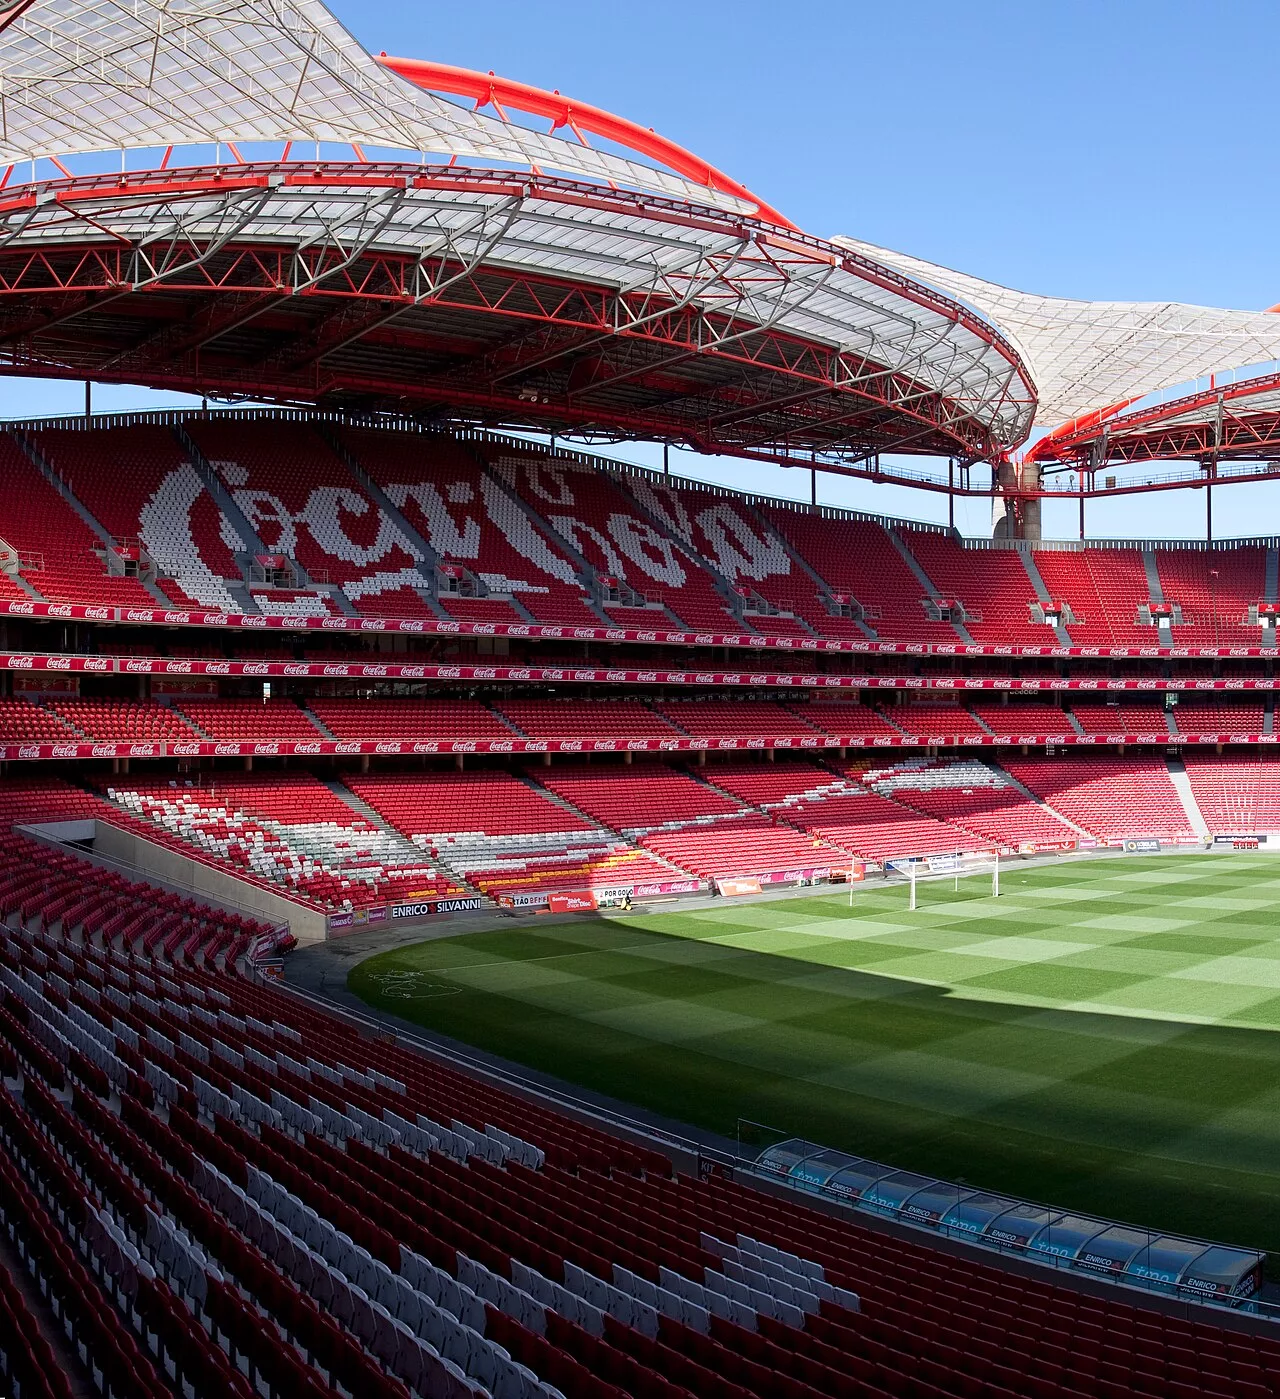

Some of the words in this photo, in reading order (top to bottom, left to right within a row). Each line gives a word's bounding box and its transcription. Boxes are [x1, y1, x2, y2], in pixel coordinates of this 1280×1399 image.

[392, 905, 428, 918] ENRICO
[437, 899, 481, 913] SILVANNI
[907, 1205, 931, 1217] ENRICO
[991, 1229, 1017, 1242] ENRICO
[1085, 1253, 1112, 1267] ENRICO
[1187, 1277, 1217, 1291] ENRICO
